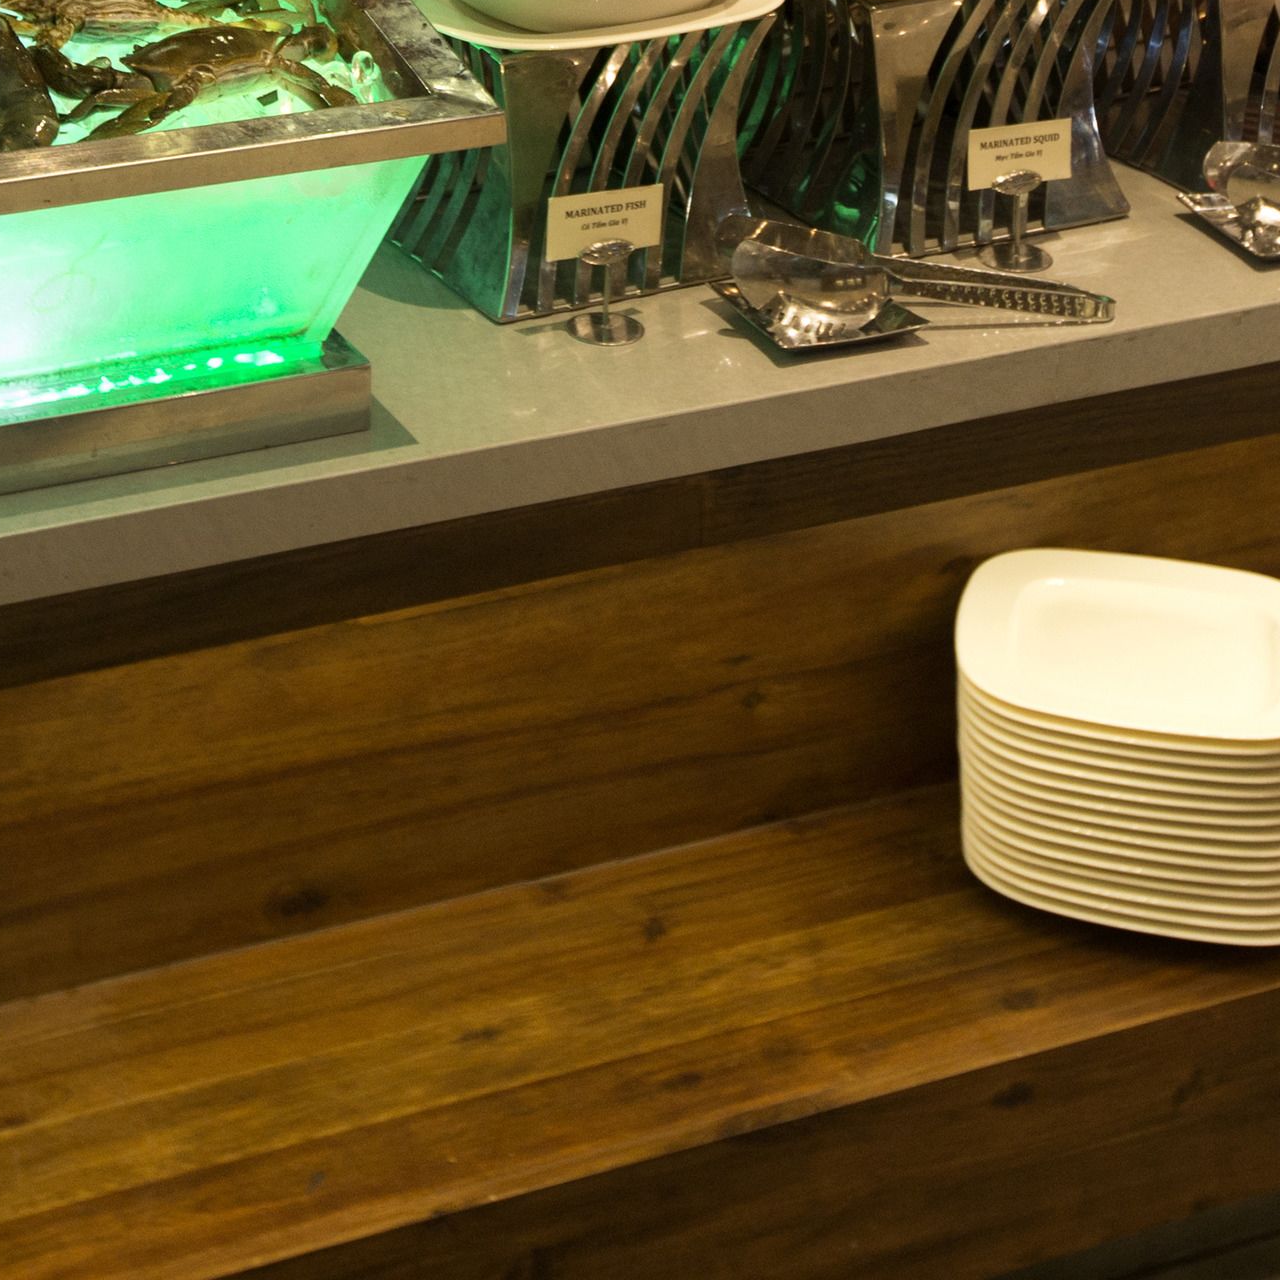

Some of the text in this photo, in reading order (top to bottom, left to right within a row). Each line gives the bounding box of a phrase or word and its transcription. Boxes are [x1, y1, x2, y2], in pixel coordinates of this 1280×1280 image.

[979, 133, 1060, 149] MARINATED SQUID
[564, 200, 647, 219] MARINATED FISH
